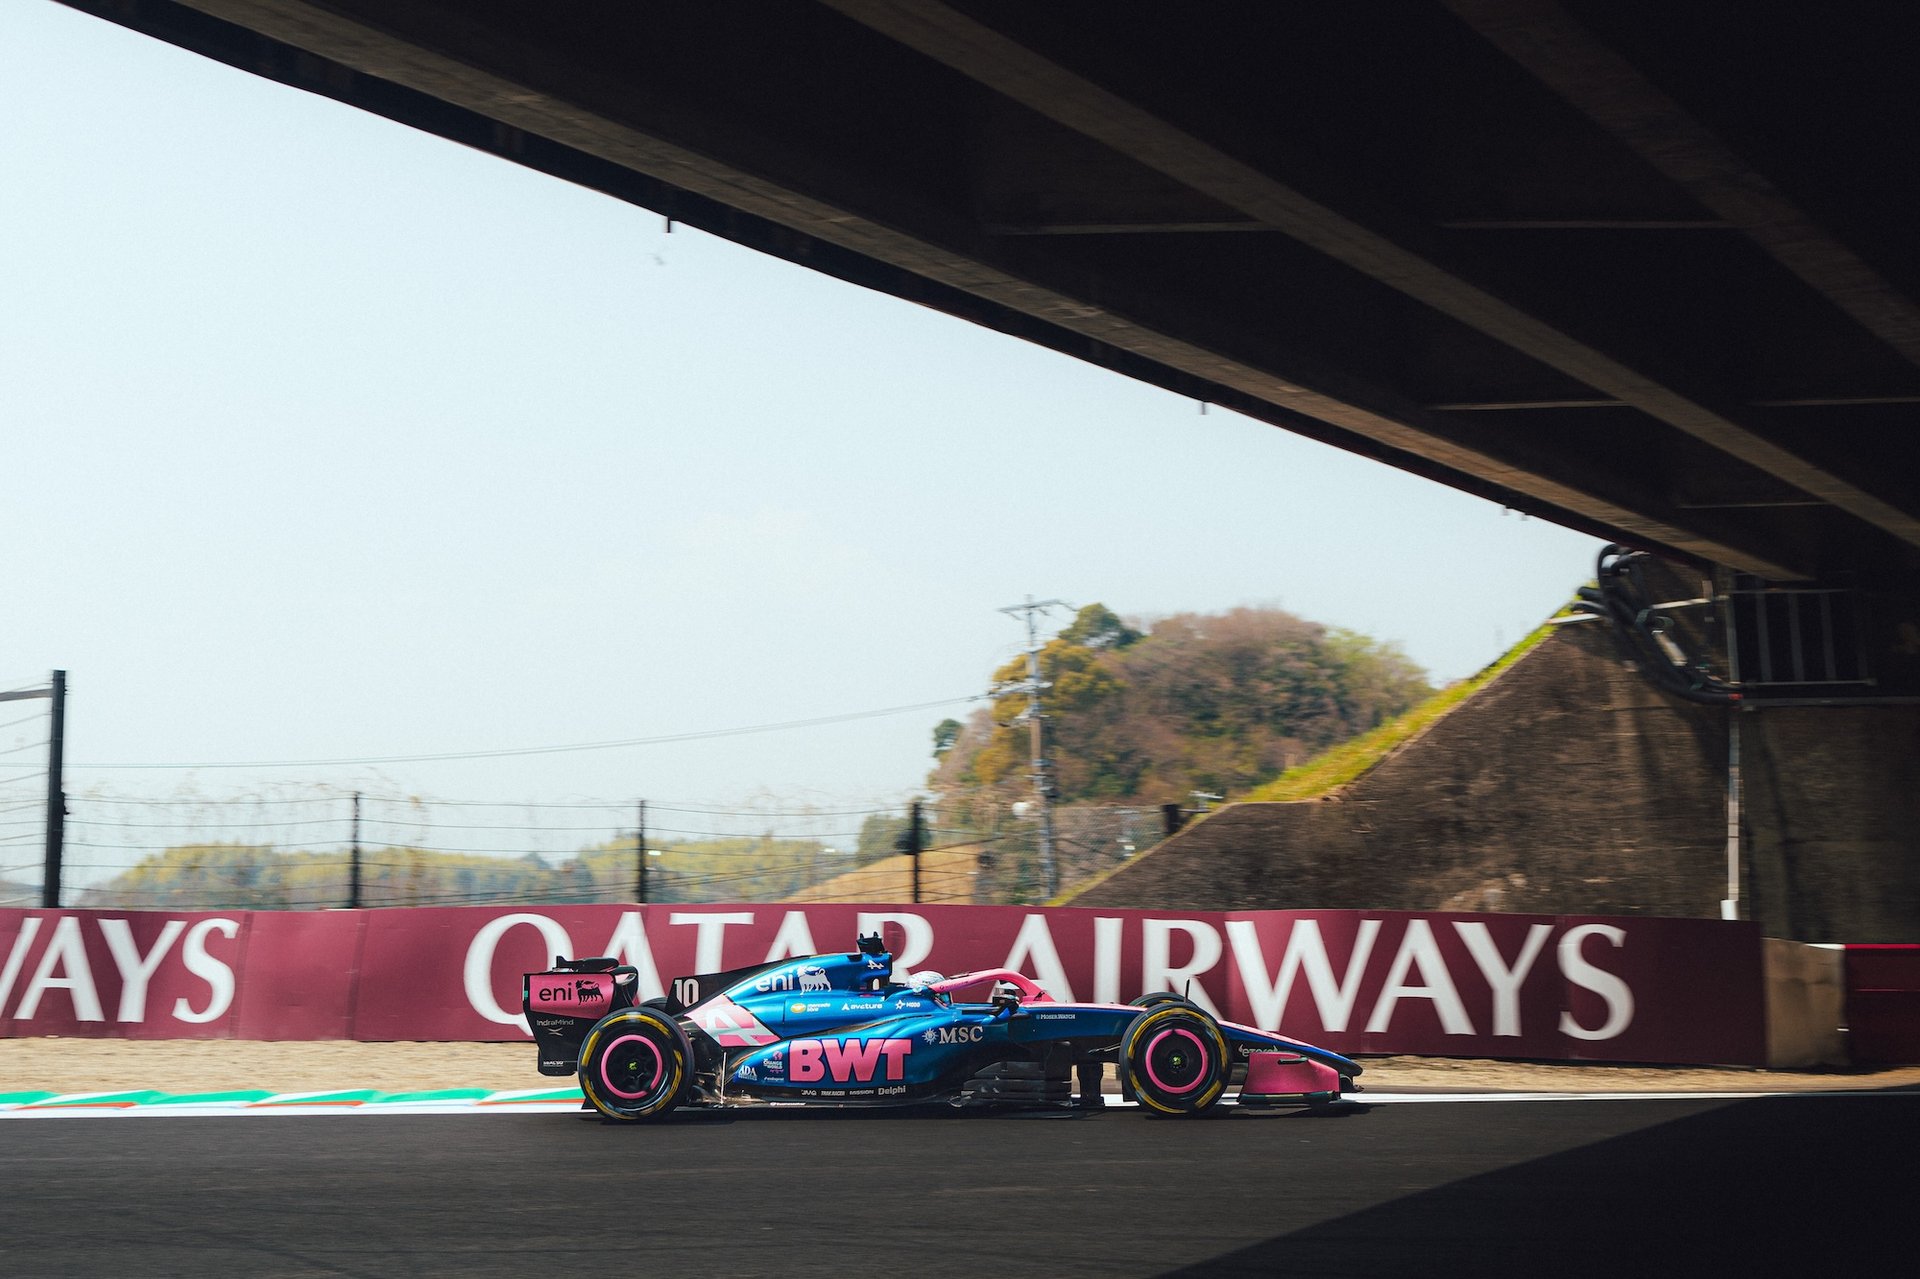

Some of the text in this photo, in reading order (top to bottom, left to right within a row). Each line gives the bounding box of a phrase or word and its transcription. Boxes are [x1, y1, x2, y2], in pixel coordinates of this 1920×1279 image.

[756, 971, 794, 993] eni
[988, 913, 1634, 1040] AIRWAYS
[538, 982, 572, 1001] eni
[674, 979, 699, 1008] 10
[939, 1026, 984, 1044] MSC
[790, 1039, 912, 1082] BWT
[878, 1085, 906, 1096] Delphi
